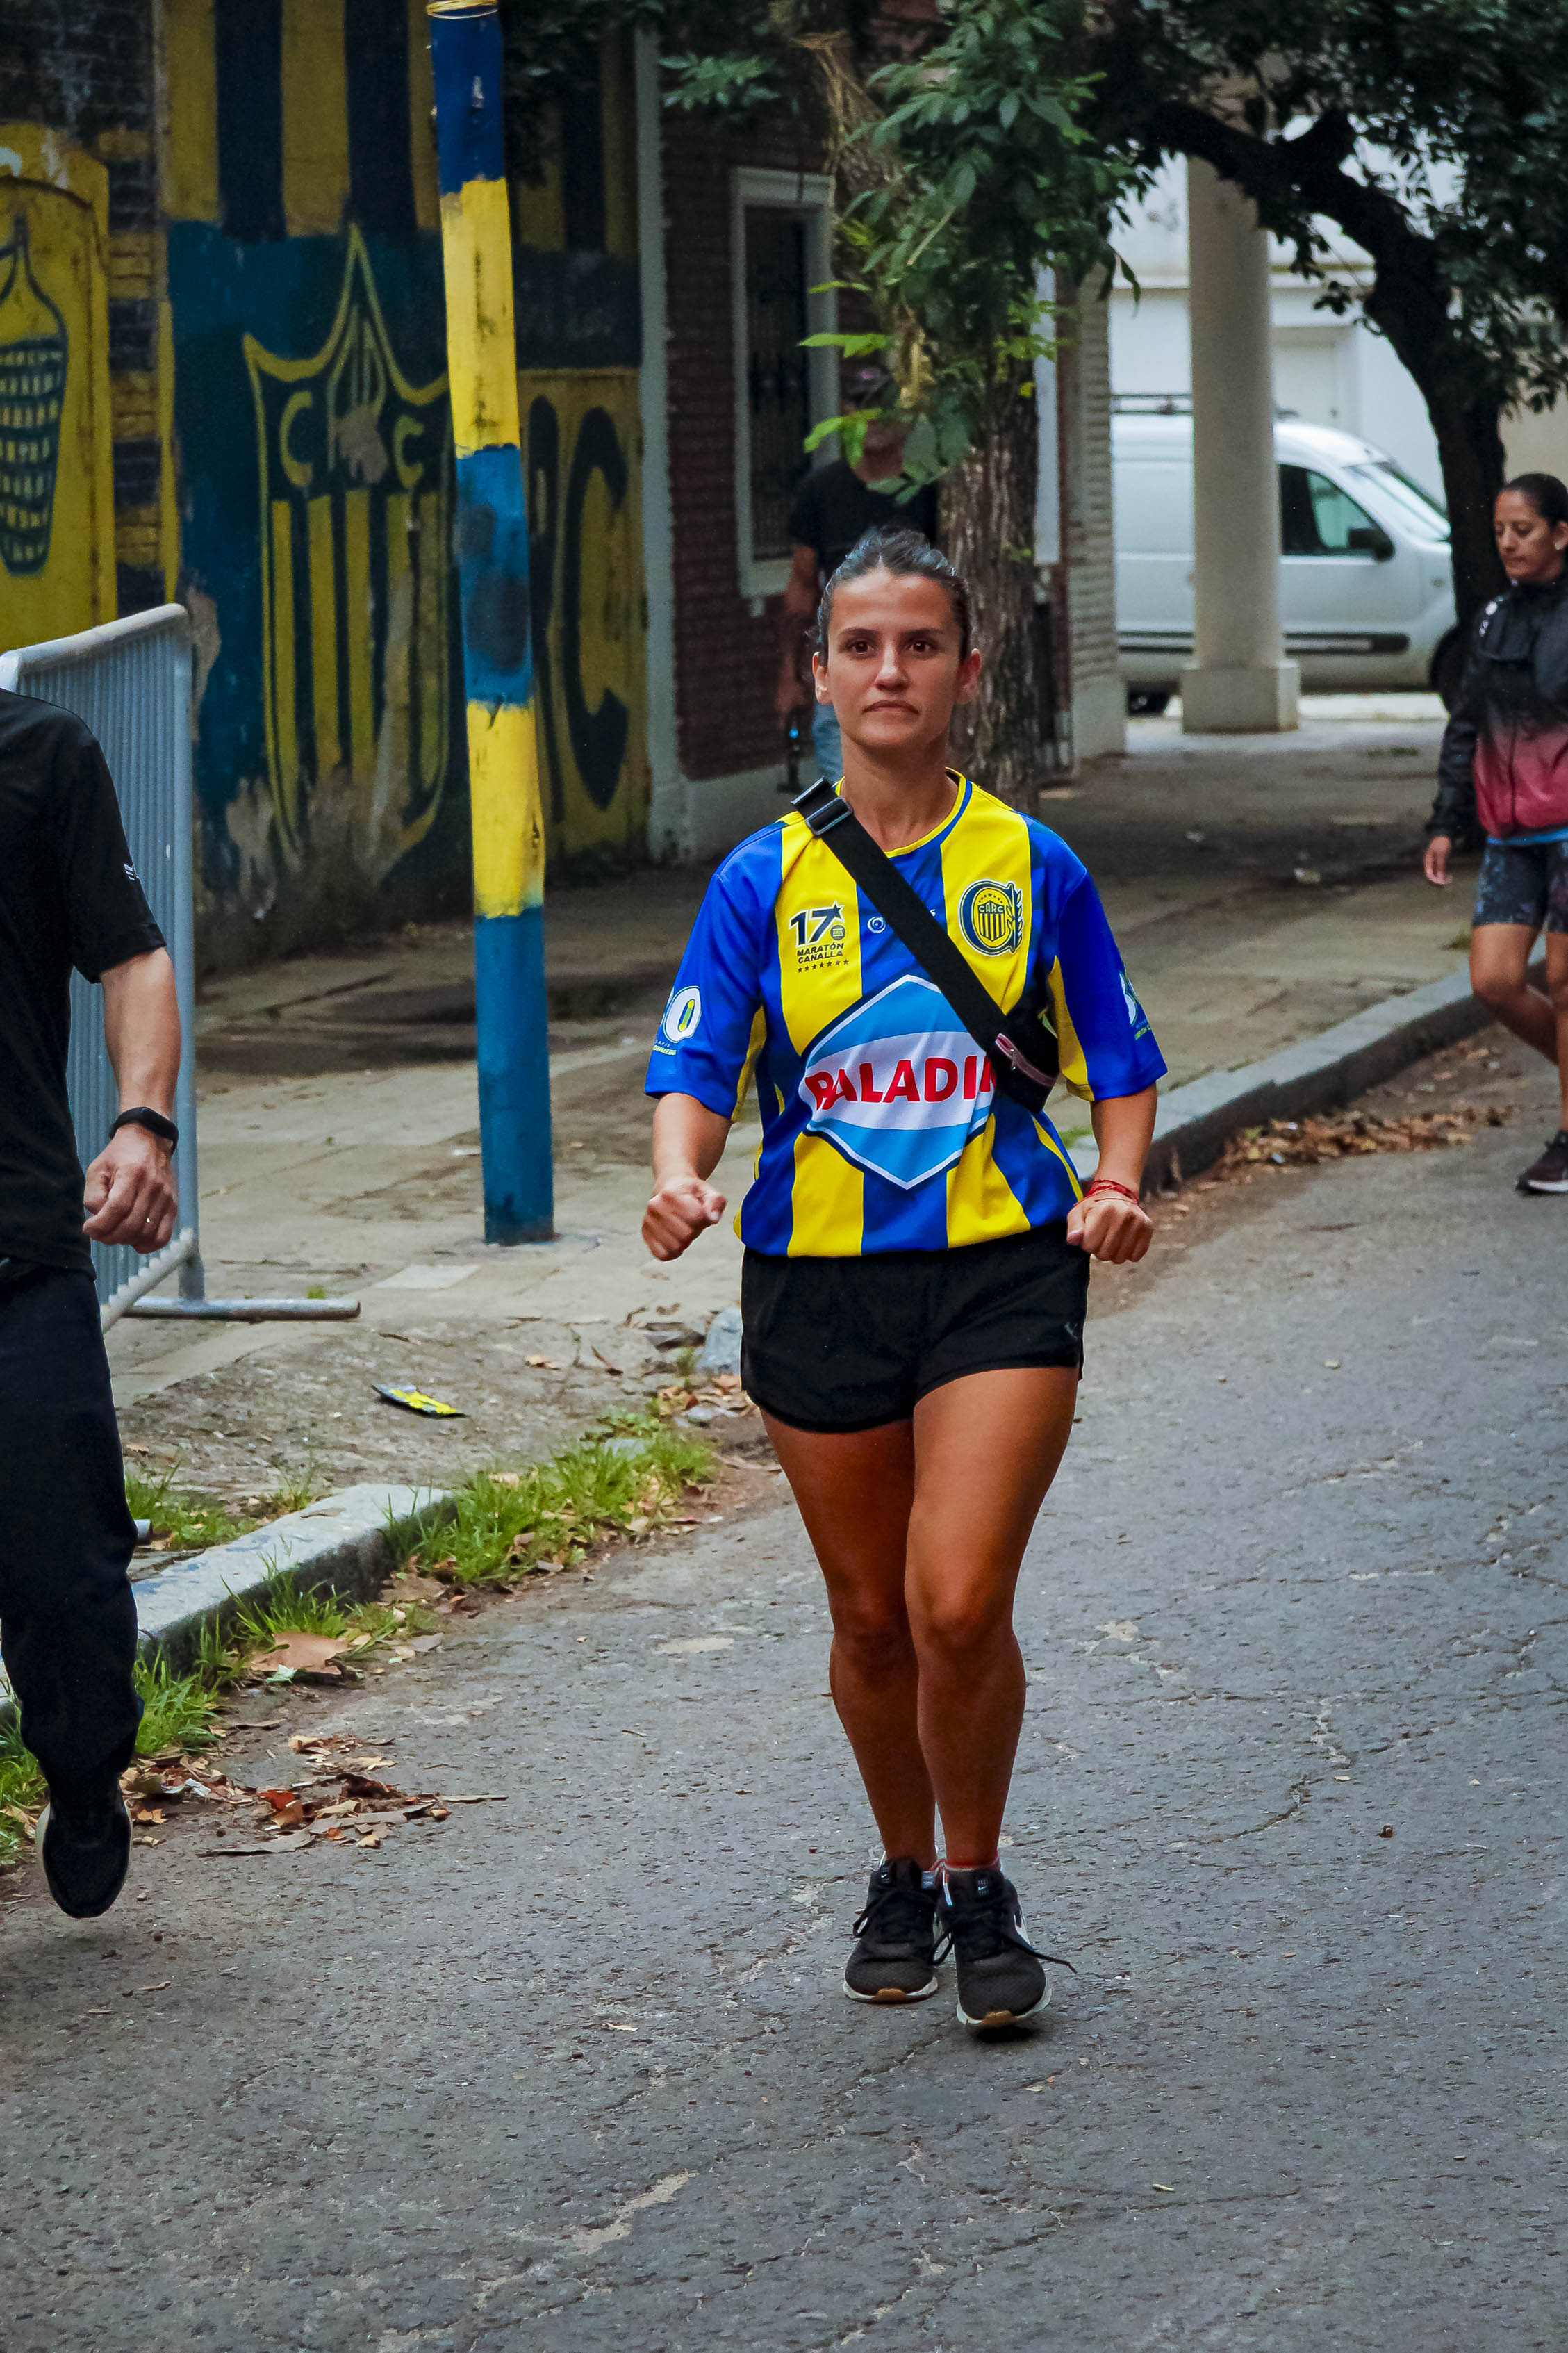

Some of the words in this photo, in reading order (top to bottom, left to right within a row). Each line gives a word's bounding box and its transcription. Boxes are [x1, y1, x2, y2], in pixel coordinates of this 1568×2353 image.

[978, 903, 1004, 913] CARC
[789, 903, 844, 947] 17
[797, 942, 844, 956] MARATÓN
[798, 950, 843, 964] CANALLA
